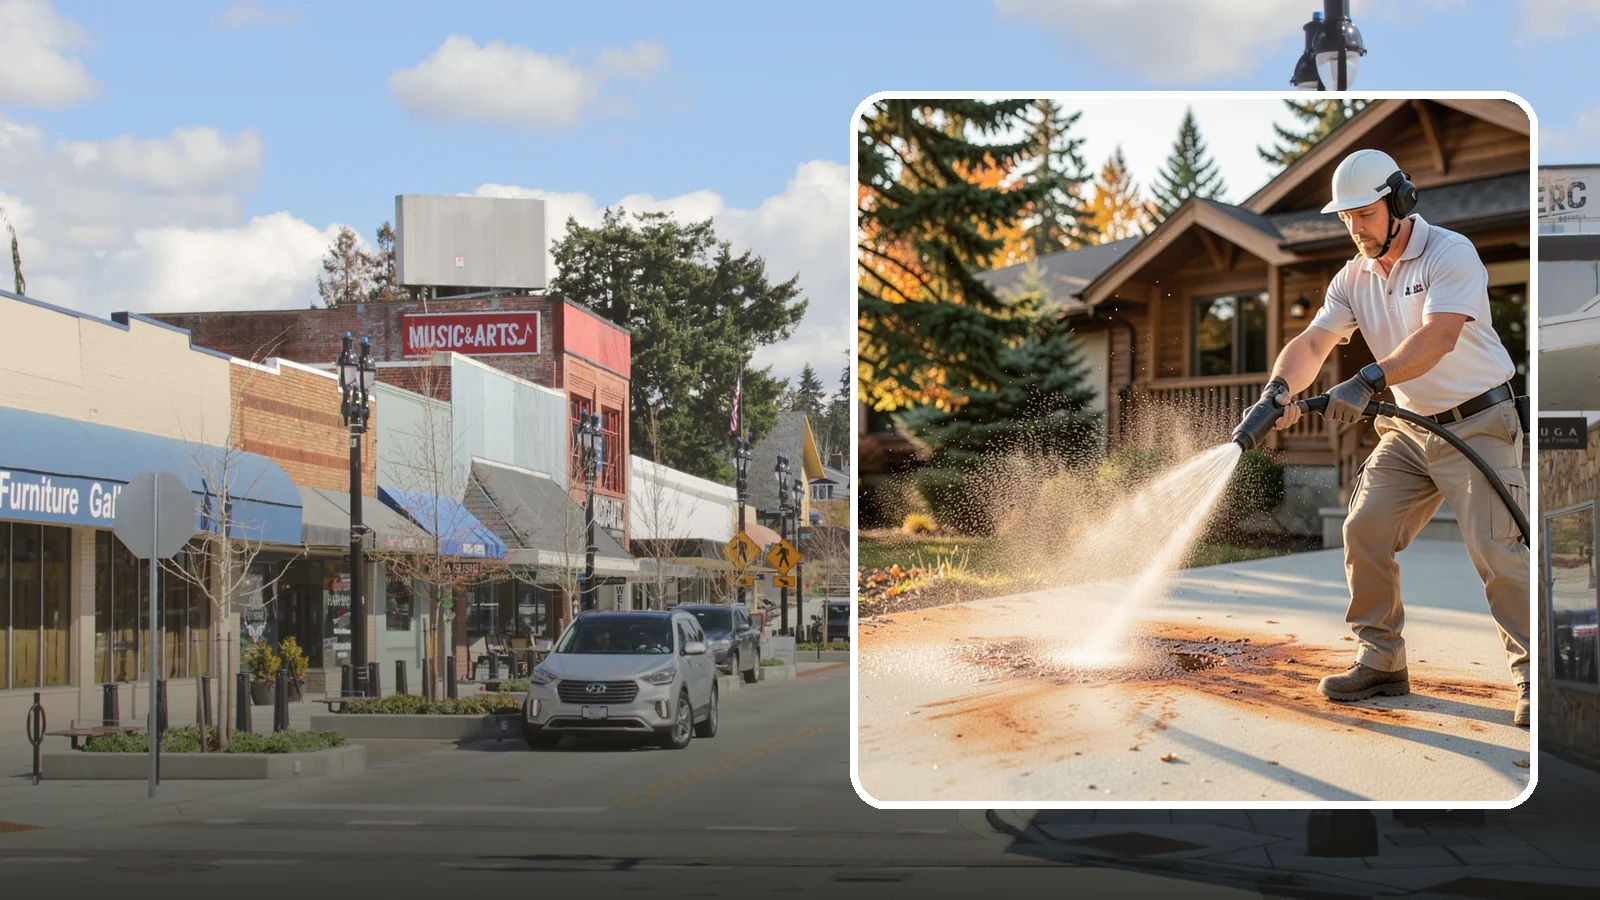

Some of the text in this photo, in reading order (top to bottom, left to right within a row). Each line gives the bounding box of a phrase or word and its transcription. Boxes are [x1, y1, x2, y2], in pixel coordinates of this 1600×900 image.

[409, 322, 521, 349] MUSIC&ARTS
[0, 471, 122, 519] Furniture Gal
[453, 563, 480, 574] SUSHI
